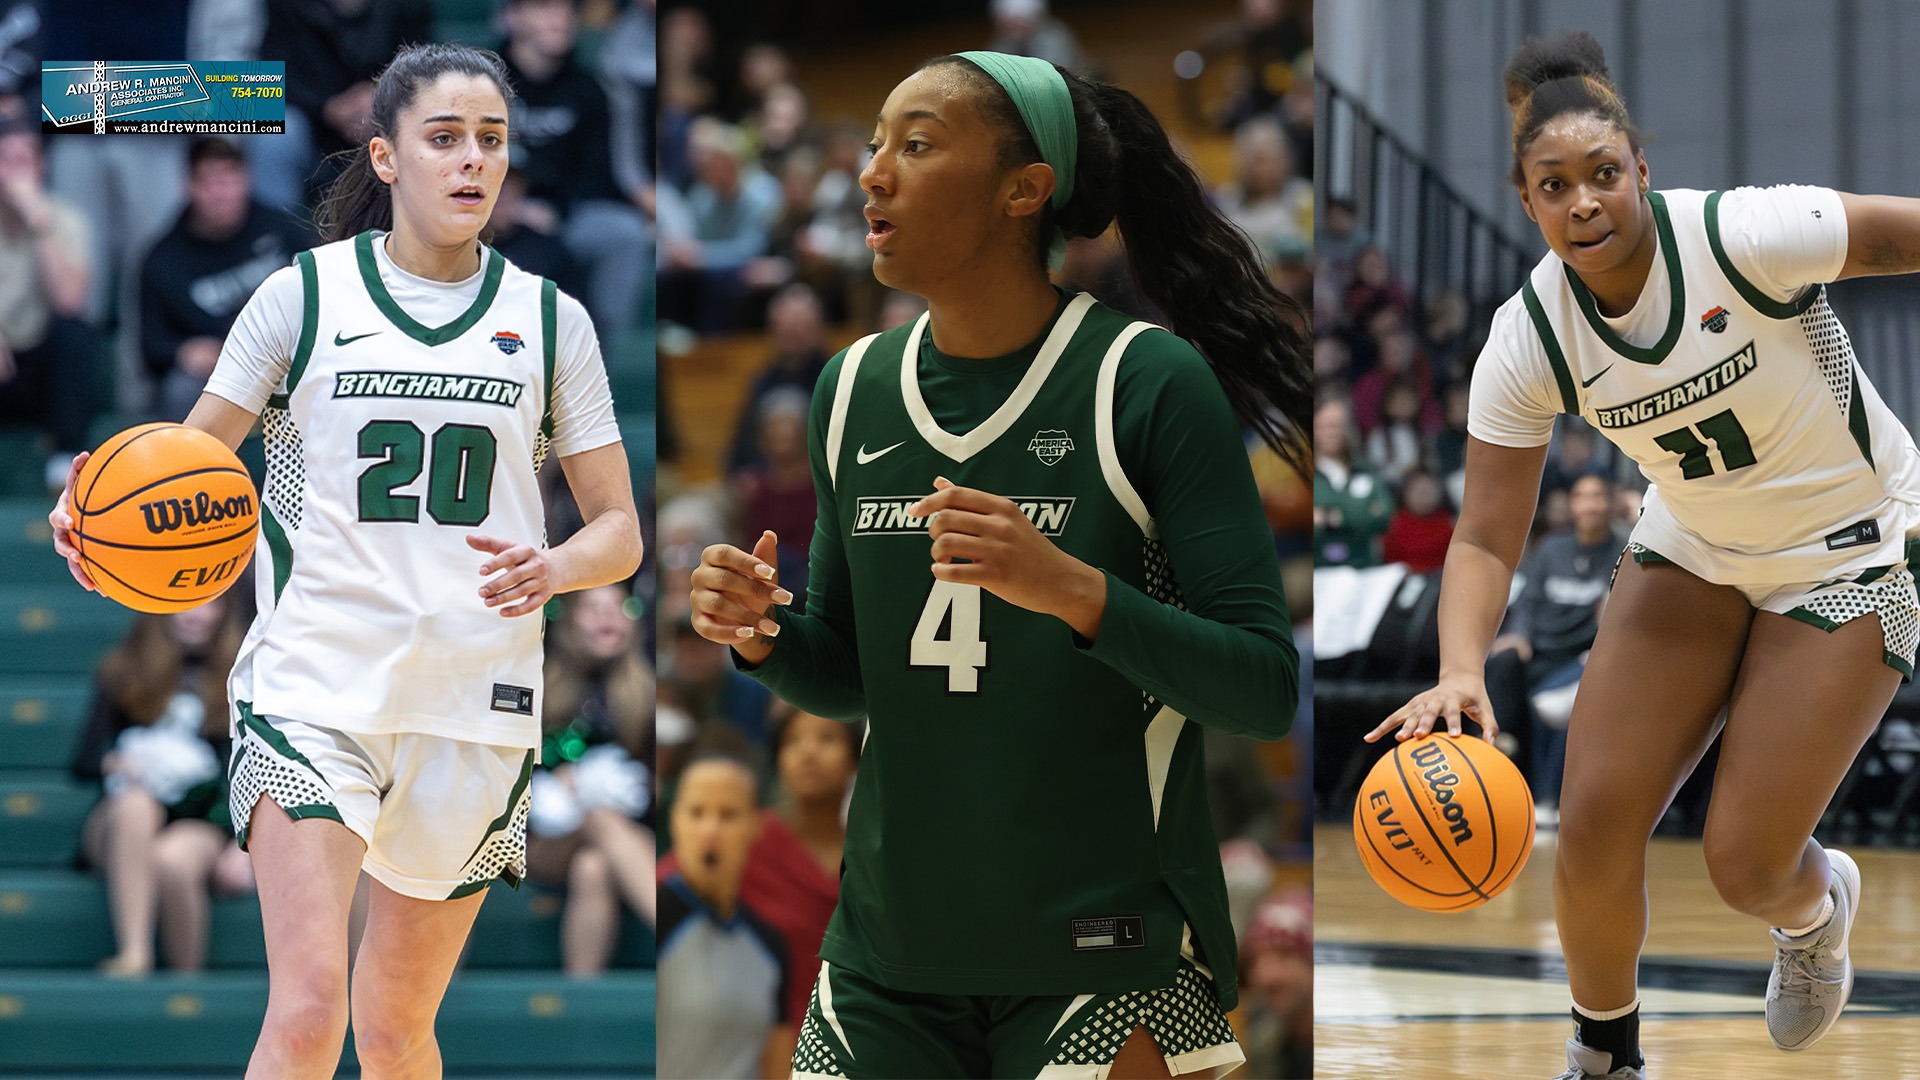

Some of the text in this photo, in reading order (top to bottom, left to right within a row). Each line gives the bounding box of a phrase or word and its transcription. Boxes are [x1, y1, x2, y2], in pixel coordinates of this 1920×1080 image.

[335, 373, 523, 405] BINGHAMTON
[1598, 346, 1756, 428] BINGHAMTON
[1029, 440, 1074, 450] AMERICA
[357, 420, 497, 527] 20
[139, 491, 252, 535] Wilson
[1862, 526, 1872, 537] M
[168, 555, 239, 588] EVO
[908, 577, 988, 693] 4
[1410, 742, 1473, 847] Wilson
[1369, 790, 1415, 851] EVO
[1411, 847, 1434, 866] NXT
[1125, 925, 1133, 939] L
